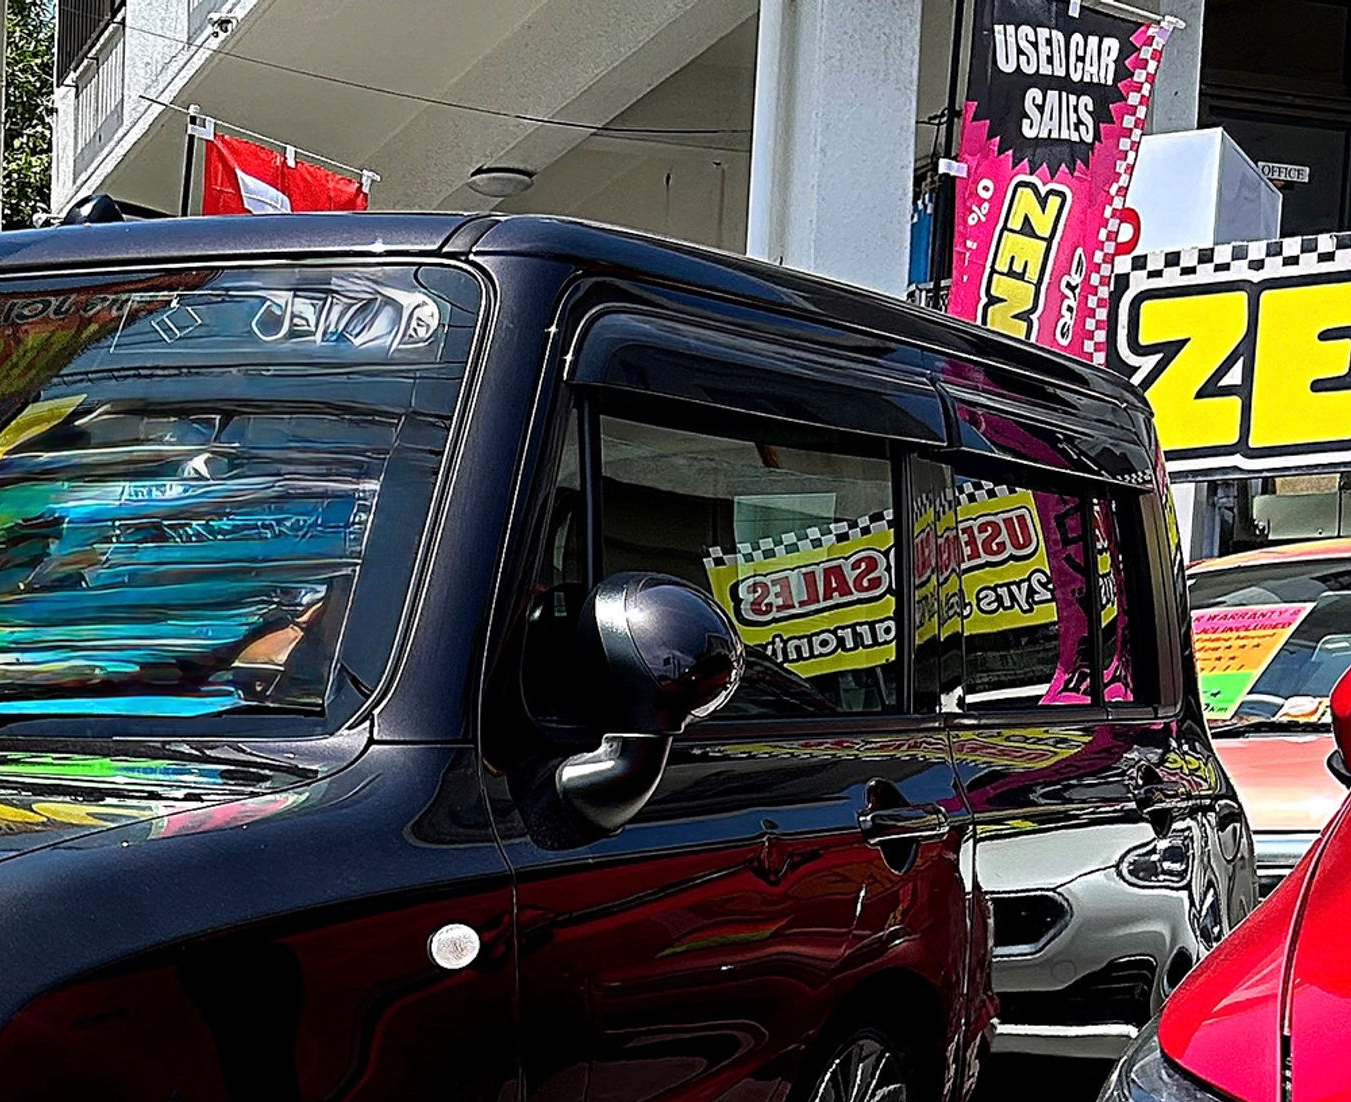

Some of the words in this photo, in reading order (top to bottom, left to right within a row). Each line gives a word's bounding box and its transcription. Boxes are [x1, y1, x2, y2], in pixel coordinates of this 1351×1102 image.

[994, 25, 1066, 77] USED
[1069, 32, 1120, 86] CAR
[1021, 87, 1095, 144] SALES
[1261, 164, 1305, 180] OFFICE
[984, 183, 1064, 341] ZEN
[1133, 280, 1351, 454] ZE
